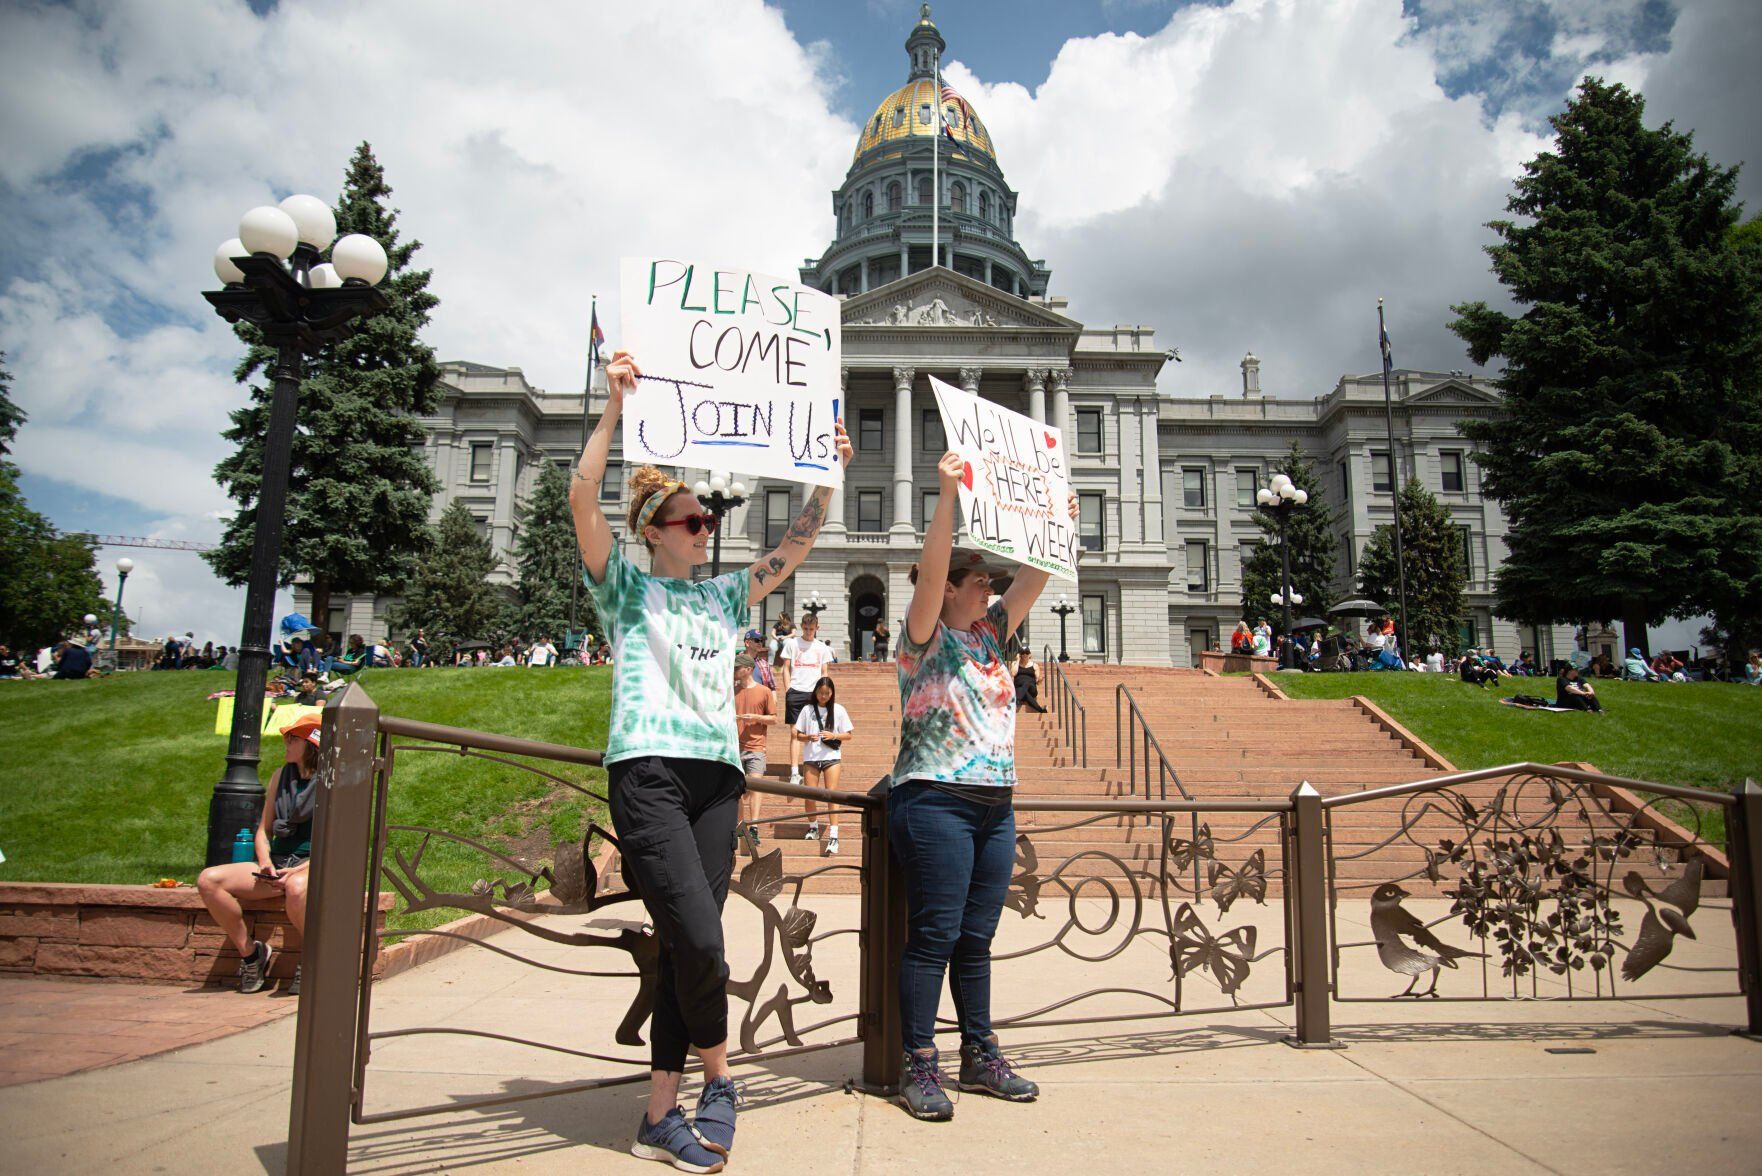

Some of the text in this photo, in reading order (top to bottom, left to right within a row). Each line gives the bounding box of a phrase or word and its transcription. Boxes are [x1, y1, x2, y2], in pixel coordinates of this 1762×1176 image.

[690, 319, 810, 387] COME
[635, 374, 773, 459] JOIN
[935, 385, 1064, 479] We'll be
[993, 462, 1047, 508] HERE
[971, 497, 1078, 568] ALL WEEK
